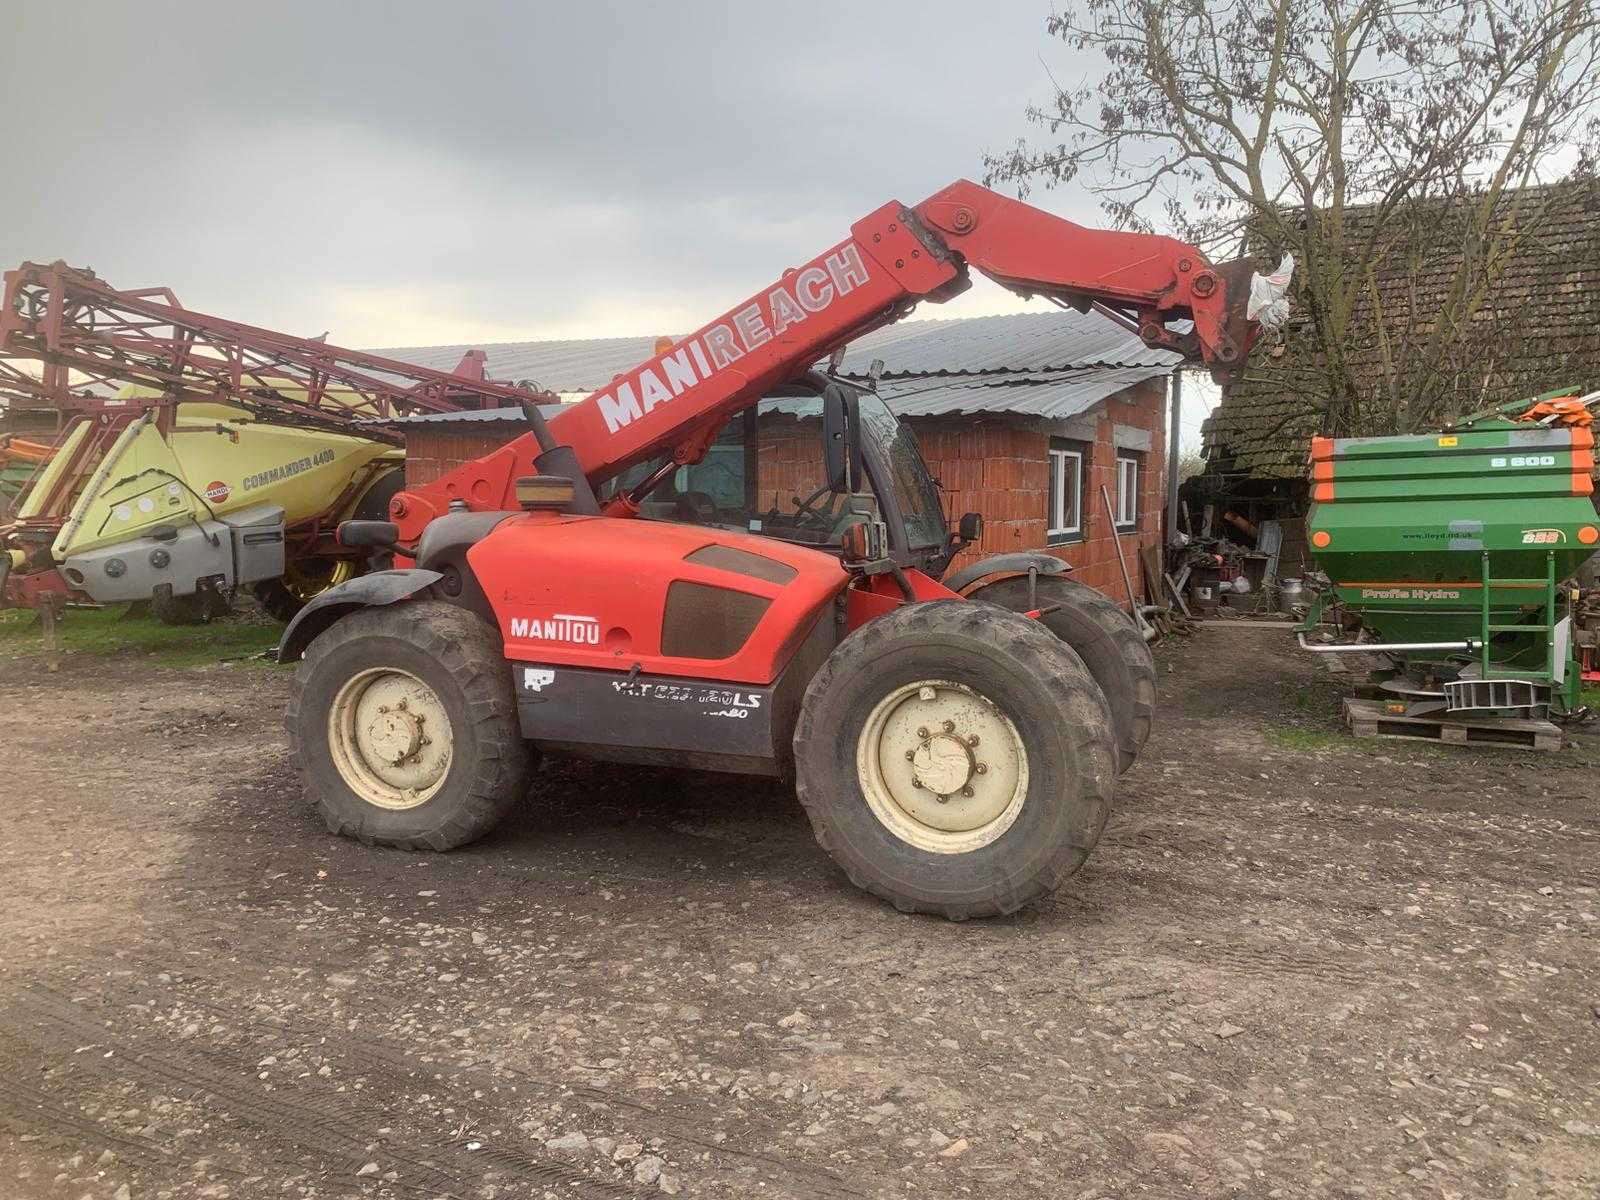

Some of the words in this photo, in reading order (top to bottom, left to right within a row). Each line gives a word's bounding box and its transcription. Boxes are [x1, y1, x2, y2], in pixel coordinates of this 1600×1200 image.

[595, 242, 871, 435] MANIREACH
[242, 456, 313, 491] COMMANDER
[1362, 588, 1410, 599] Profis
[1412, 588, 1460, 601] Hydro
[510, 613, 600, 645] MANITOU
